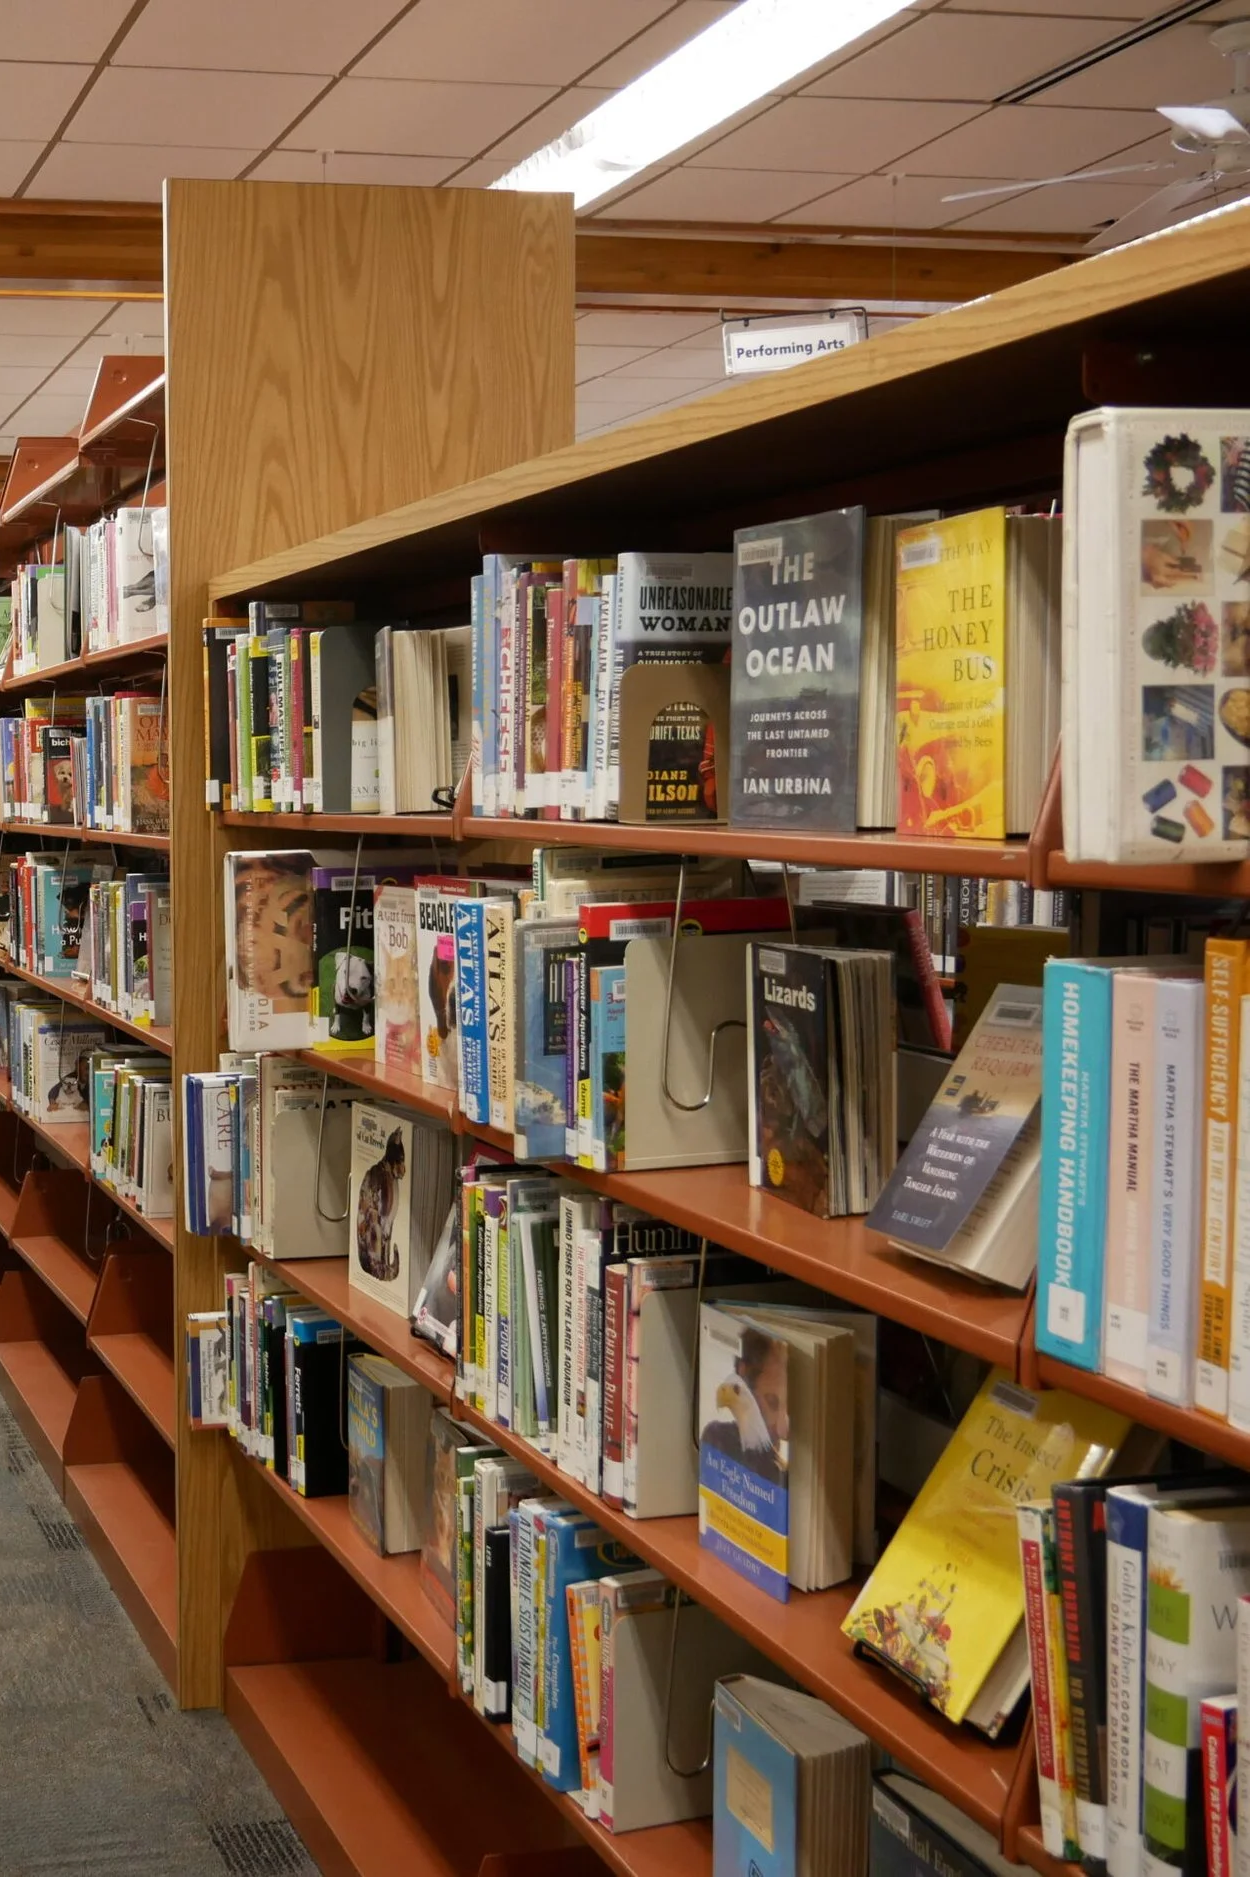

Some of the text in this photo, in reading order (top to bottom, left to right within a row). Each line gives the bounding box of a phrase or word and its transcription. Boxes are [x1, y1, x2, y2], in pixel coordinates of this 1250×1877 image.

[737, 339, 845, 359] Performing Arts
[770, 552, 815, 585] THE
[964, 539, 994, 554] MAY
[640, 585, 733, 611] UNREASONABLE
[738, 595, 846, 636] OUTLAW
[948, 584, 993, 613] THE
[598, 591, 610, 673] TAKING AIM
[641, 616, 731, 632] WOMAN
[924, 620, 994, 652] HONEY
[615, 649, 624, 664] AN
[745, 642, 835, 678] OCEAN
[953, 655, 993, 682] BUS
[277, 662, 286, 765] BULLMASTIFFS
[596, 689, 607, 713] EVA
[750, 709, 827, 723] JOURNEYS ACROSS
[957, 716, 969, 728] and
[677, 726, 700, 740] TEXAS
[746, 728, 829, 741] THE LAST UNTAMED
[766, 748, 808, 759] FRONTIER
[743, 777, 832, 795] IAN URBINA
[400, 908, 415, 921] from
[961, 878, 971, 906] BOB
[339, 906, 373, 929] Pit
[388, 926, 408, 949] Bob
[456, 908, 475, 1027] ATLAS
[471, 930, 480, 991] AXELROD'S
[486, 918, 501, 1042] ATLAS
[579, 952, 587, 1070] Freshwater Aquariums
[764, 977, 815, 1012] Lizards
[1210, 956, 1231, 1118] SELF-SUFFICIENCY
[217, 1090, 233, 1150] CARE
[1055, 981, 1080, 1289] HOMEKEEPING HANDBOOK
[1077, 1072, 1089, 1207] MARTHA STEWART'S
[1126, 1062, 1140, 1193] THE MARTHA MANUAL
[922, 1162, 958, 1180] VANISHING
[1160, 1063, 1176, 1331] MARTHA STEWART'S VERY GOOD THINGS
[1211, 1126, 1226, 1280] FOR THE CENTURY
[485, 1227, 493, 1323] TROPICAL FISH
[535, 1269, 552, 1388] RAISING EARTHWORMS
[563, 1208, 573, 1406] JUMBO FISHES FOR THE LARGE AQUARIUM
[576, 1246, 585, 1383] THE URBAN WILDLIFE GARDENER
[605, 1287, 618, 1373] LAST CHAIN
[500, 1322, 509, 1360] POND
[294, 1367, 302, 1414] Ferrets
[604, 1382, 617, 1429] BILLIE
[983, 1414, 1065, 1471] The Insect
[706, 1452, 775, 1504] An Eagle Named
[721, 1479, 757, 1513] Freedom
[971, 1448, 1036, 1502] Crisis
[1031, 1561, 1041, 1588] THE
[1057, 1500, 1081, 1662] ANTHONY BOURDAIN
[518, 1516, 533, 1704] ATTAINABLE SUSTAINABLE
[551, 1653, 560, 1708] Complete
[1069, 1678, 1082, 1702] NO
[1119, 1560, 1136, 1781] Goldy's Kitchen COOKBOOK
[1109, 1603, 1119, 1804] DIANE MOTT DAVIDSON
[1207, 1735, 1220, 1808] Calorie FAT
